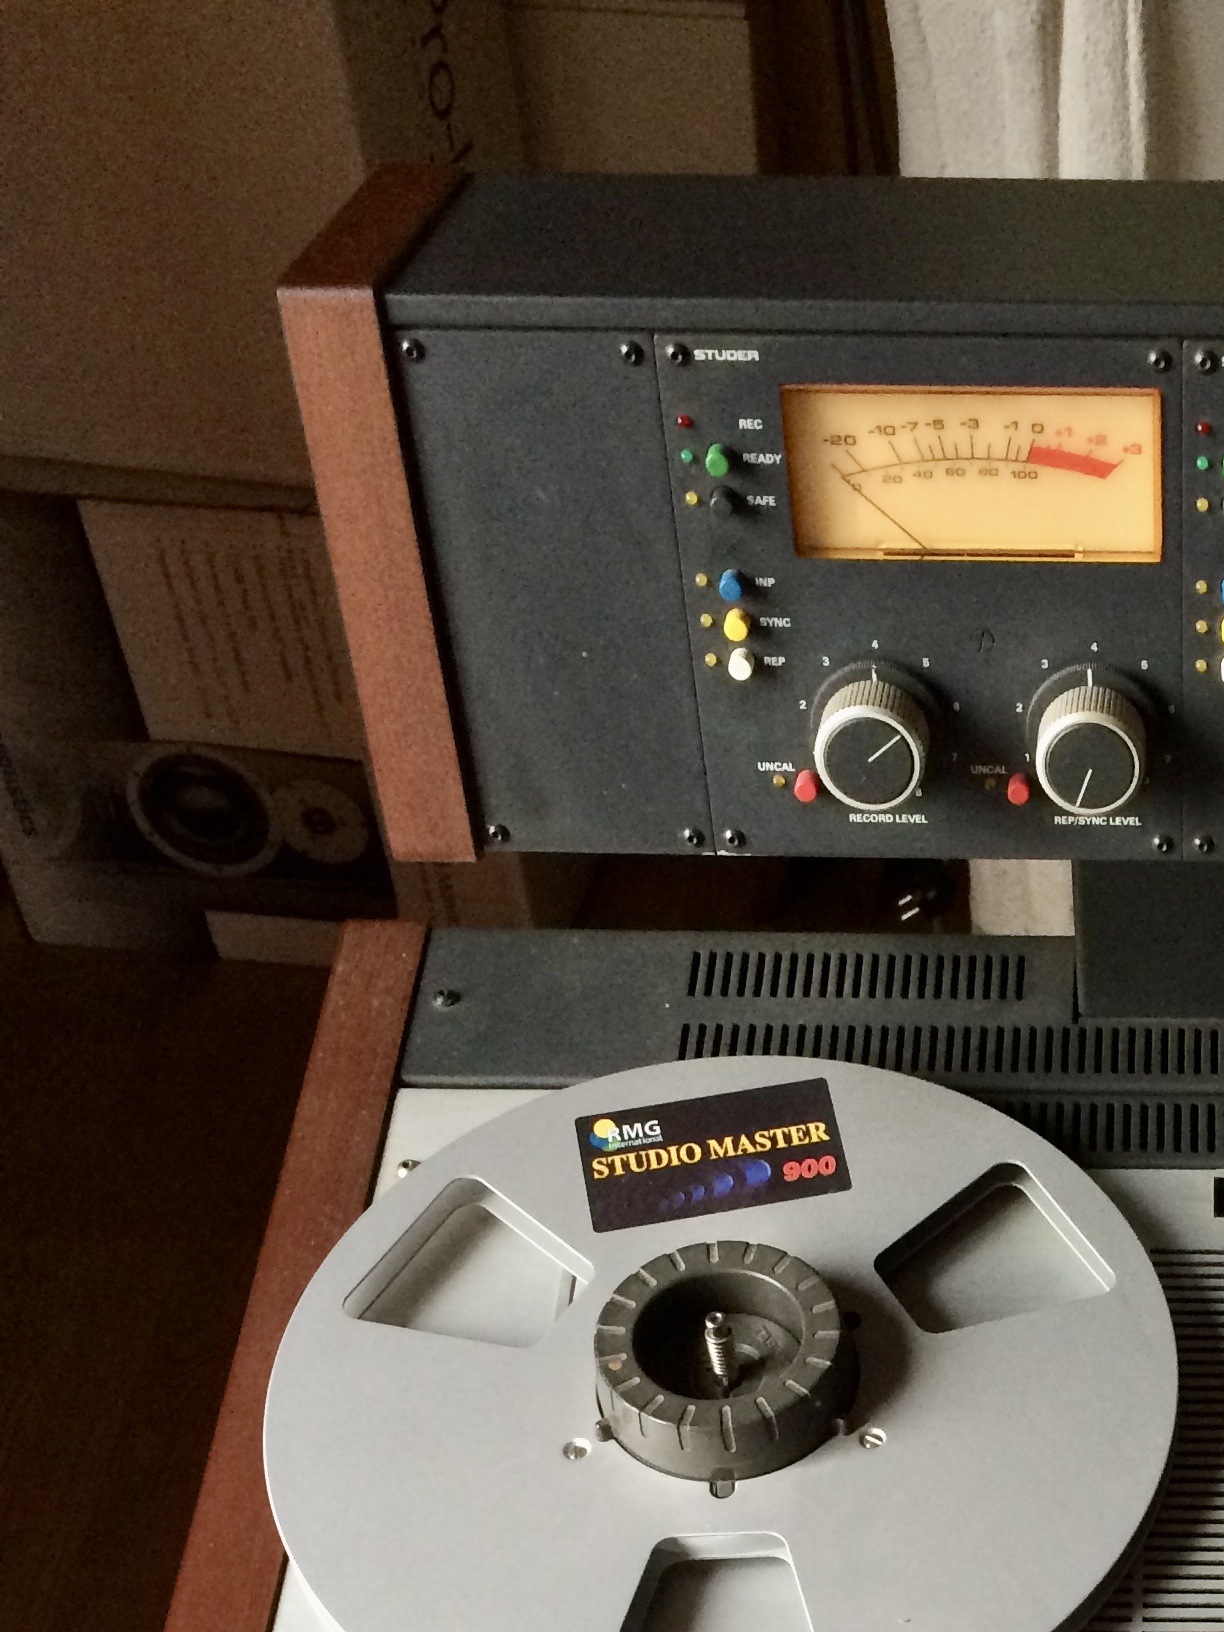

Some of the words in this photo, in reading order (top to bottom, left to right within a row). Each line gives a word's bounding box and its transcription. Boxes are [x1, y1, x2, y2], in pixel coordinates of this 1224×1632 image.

[694, 349, 759, 362] STUDER
[738, 418, 763, 431] REC
[960, 418, 980, 430] -3
[742, 453, 782, 465] READY
[1011, 470, 1038, 480] 100
[747, 495, 777, 507] SAFE
[755, 577, 776, 589] INP
[760, 617, 791, 629] SYNC
[871, 640, 879, 649] 4
[1090, 642, 1099, 652] 4
[764, 656, 786, 667] REP
[822, 656, 830, 666] 3
[1041, 659, 1049, 669] 3
[799, 700, 807, 709] 2
[1015, 703, 1023, 713] 2
[757, 761, 796, 773] UNCAL
[970, 765, 1008, 775] UNCAL
[849, 813, 892, 825] RECORD
[895, 813, 928, 825] LEVEL
[1054, 815, 1106, 828] REP/SYNC
[1109, 815, 1142, 827] LEVEL
[607, 1119, 662, 1142] RMG
[608, 1134, 664, 1150] International
[591, 1141, 702, 1180] STUDIO
[706, 1121, 831, 1160] MASTER
[782, 1155, 837, 1182] 900
